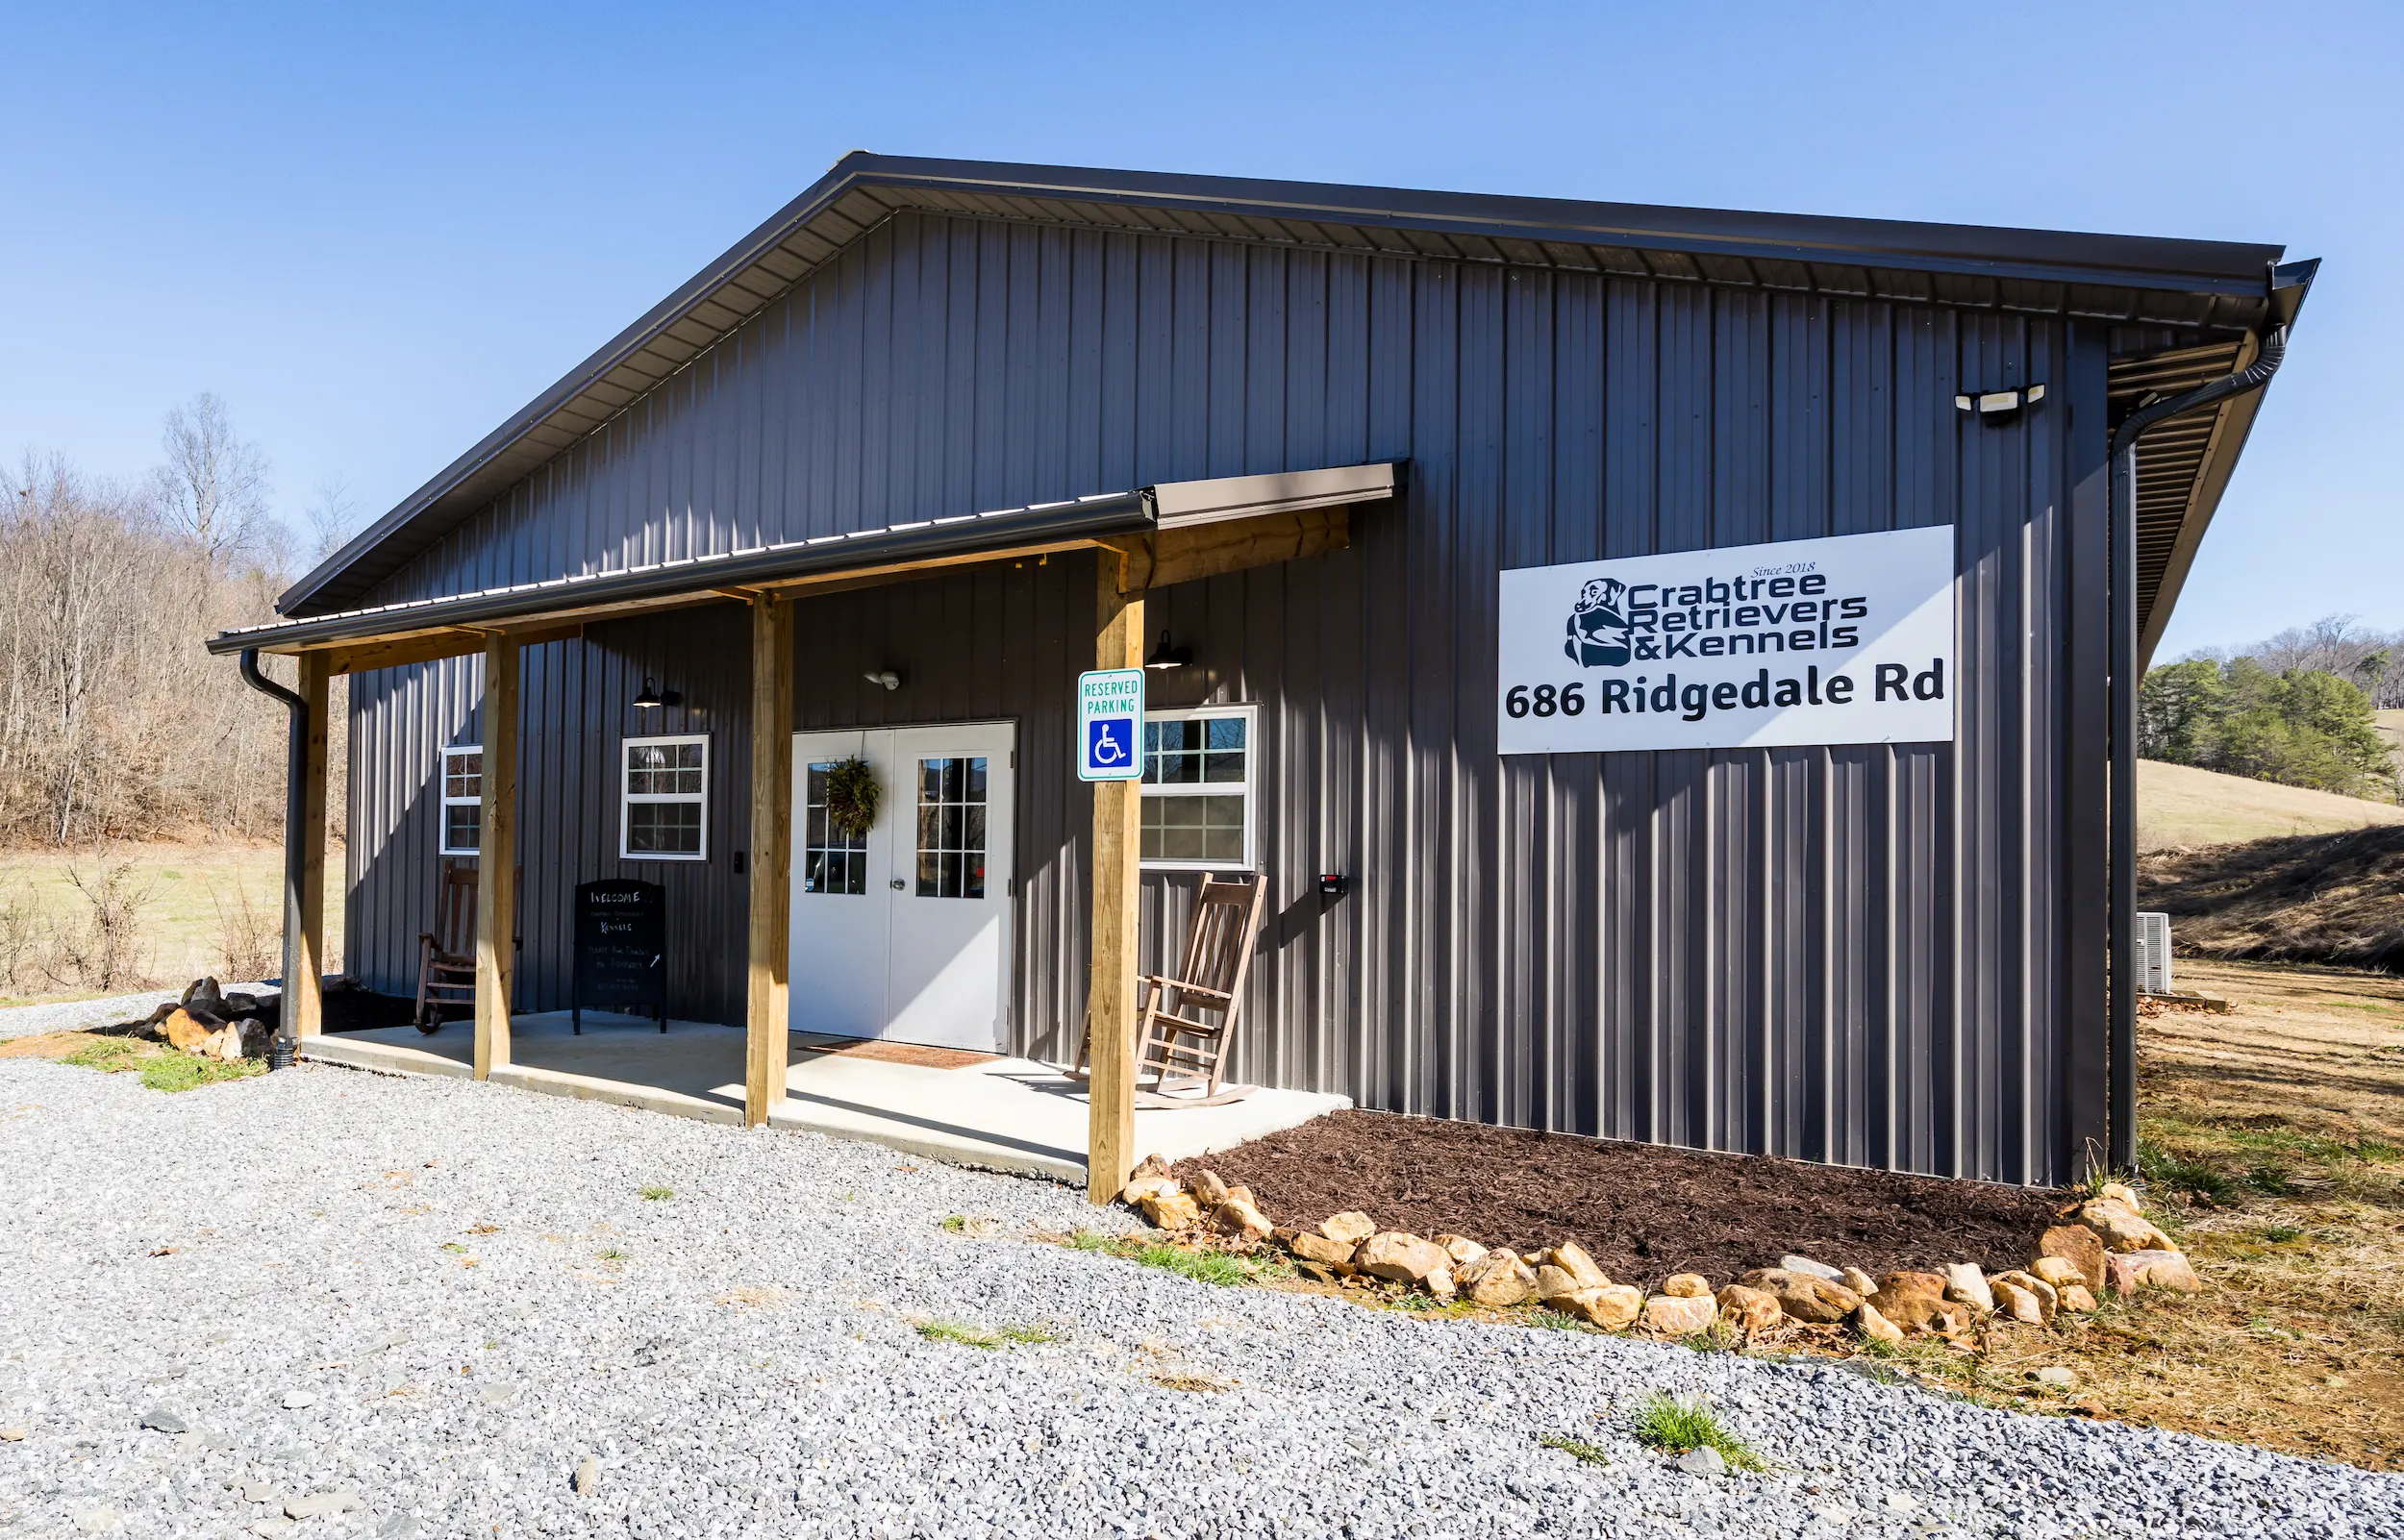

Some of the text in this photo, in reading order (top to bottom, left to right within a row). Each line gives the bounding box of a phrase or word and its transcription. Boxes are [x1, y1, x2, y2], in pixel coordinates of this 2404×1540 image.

[1750, 561, 1816, 578] Since 2018
[1628, 574, 1826, 609] Crabtree
[1627, 596, 1867, 634] Retrievers
[1085, 681, 1138, 697] RESERVED
[1505, 658, 1944, 722] 686 Ridgedale Rd
[1088, 699, 1135, 714] PARKING
[590, 891, 640, 904] WELCOME
